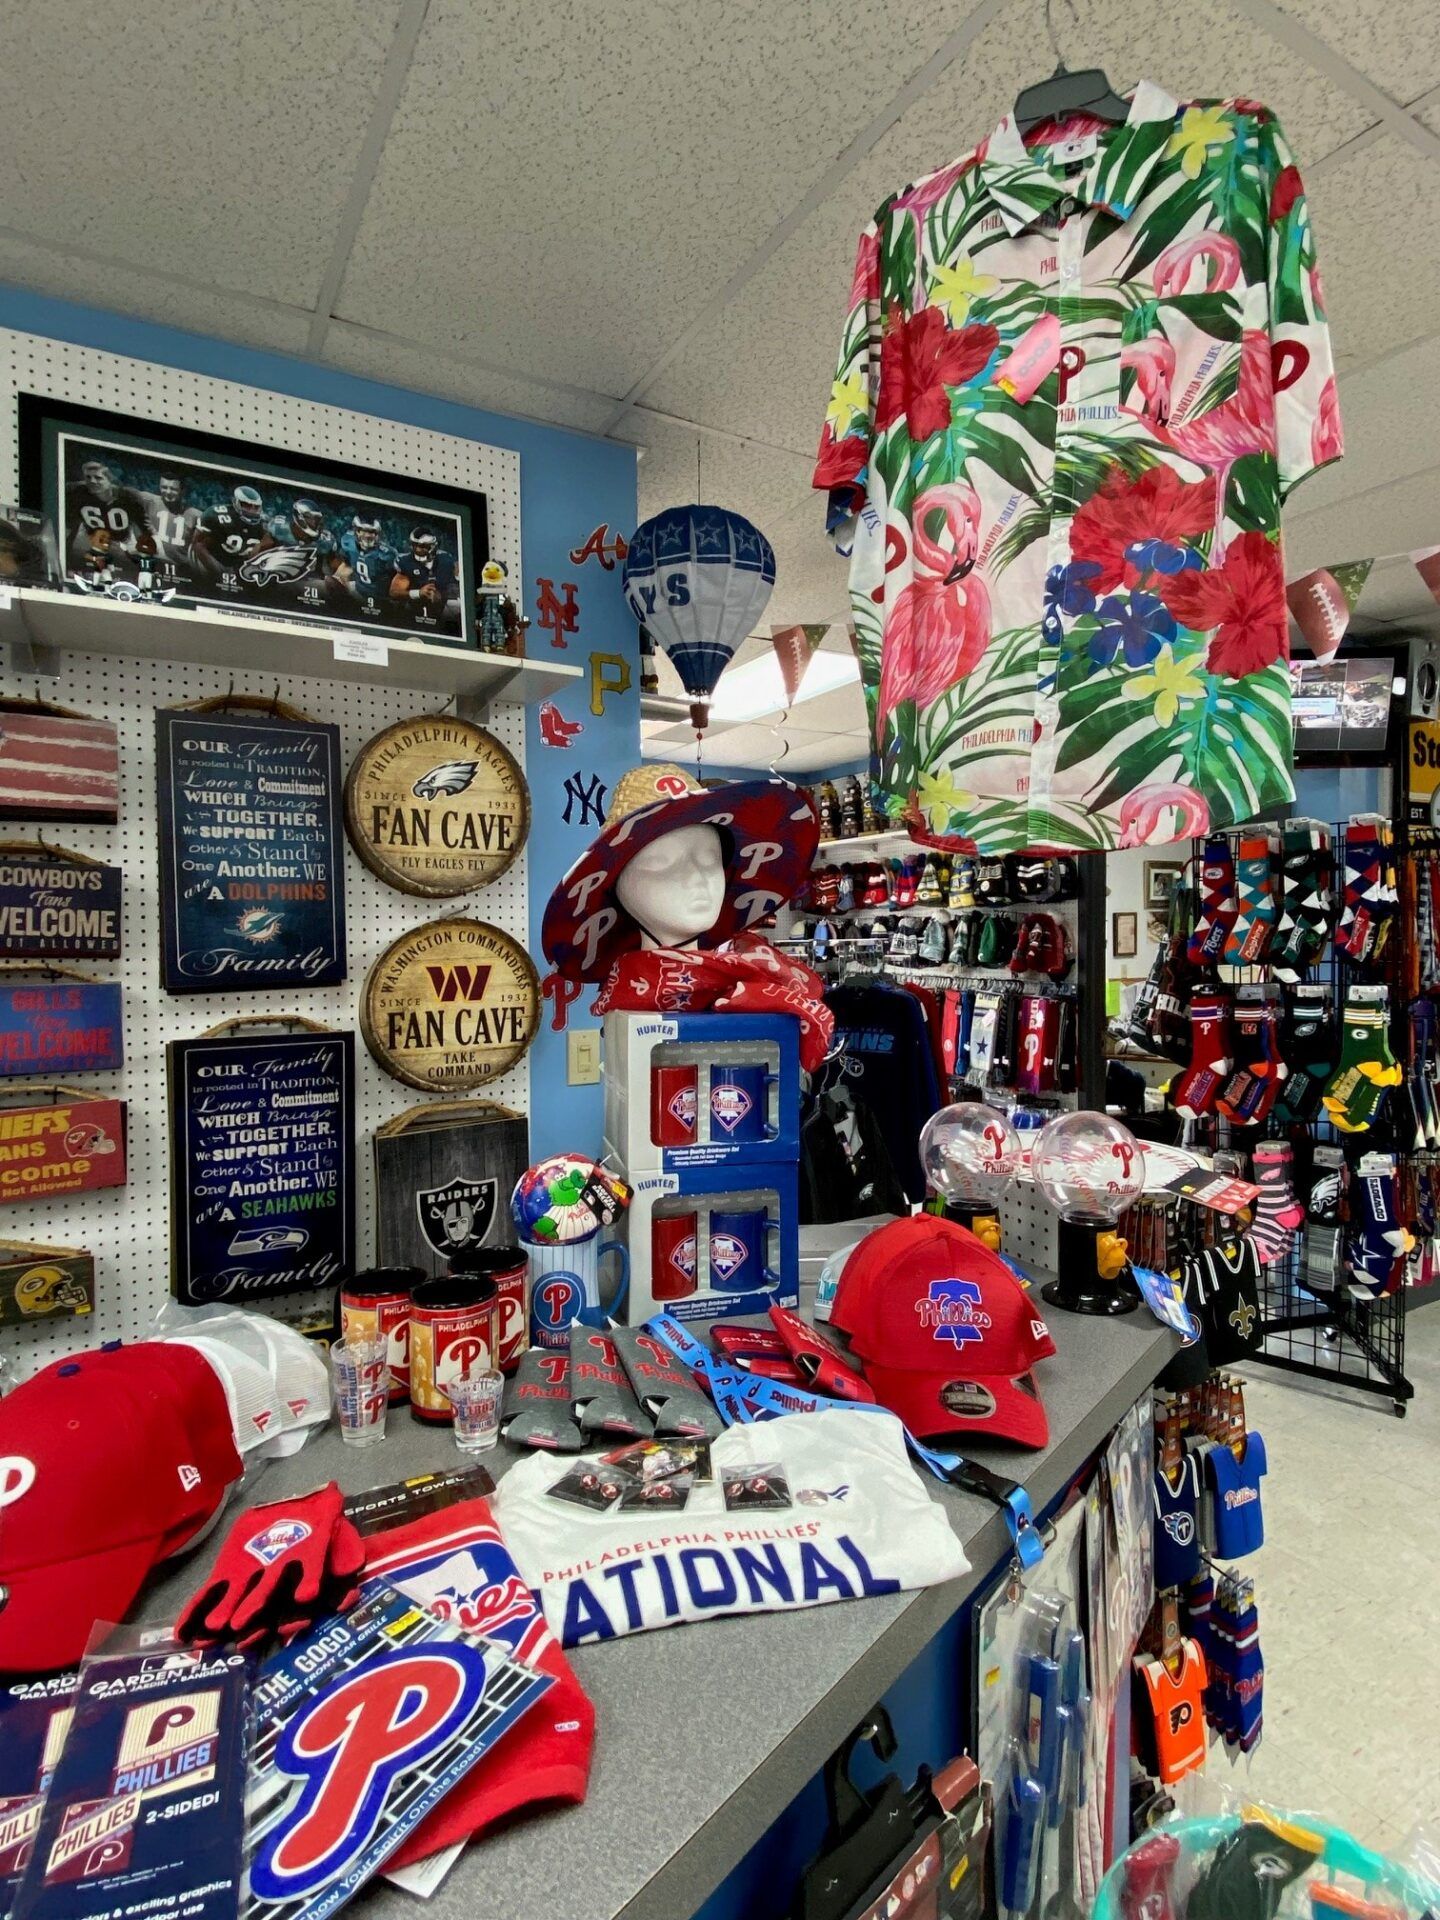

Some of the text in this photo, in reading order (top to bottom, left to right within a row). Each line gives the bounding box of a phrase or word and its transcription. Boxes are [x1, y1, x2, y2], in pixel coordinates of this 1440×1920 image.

[1078, 405, 1117, 420] PHILLIES
[81, 506, 129, 530] 60
[157, 511, 185, 546] 11
[165, 564, 176, 575] 11
[222, 573, 237, 584] 92
[357, 562, 371, 584] 9
[304, 587, 317, 598] 20
[367, 598, 374, 607] 9
[589, 652, 632, 716] P
[182, 737, 319, 763] OUR Family
[962, 729, 1015, 750] PHILADELPHIA
[368, 728, 517, 794] PHILADELPHIA EAGLES
[177, 771, 326, 796] Love & Commitment
[365, 791, 406, 801] SINCE
[184, 791, 322, 811] WHICH Brings
[488, 800, 516, 810] 1933
[213, 809, 323, 827] TOGETHER.
[372, 805, 514, 851] FAN CAVE
[182, 826, 325, 842] We SUPPORT Each
[189, 845, 228, 855] Other
[248, 843, 308, 861] Stand
[402, 856, 486, 870] FLY EAGLES FLY
[740, 841, 783, 879] P
[0, 867, 102, 890] COWBOYS
[182, 860, 214, 871] One
[303, 864, 326, 880] WE
[29, 890, 72, 907] Fans
[184, 878, 326, 900] are A DOLPHINS
[568, 870, 608, 917] P
[40, 939, 118, 949] ALLOWED
[572, 907, 618, 971] P
[1204, 925, 1224, 954] 76ers
[1245, 924, 1264, 960] Dolphins
[178, 947, 335, 978] Family
[381, 931, 530, 993] WASHINGTON COMMANDERS
[380, 998, 421, 1008] SINCE
[501, 994, 528, 1002] 1932
[540, 973, 584, 1032] P
[387, 1007, 527, 1050] FAN CAVE
[636, 1023, 675, 1037] HUNTER
[1200, 1022, 1211, 1035] P
[197, 1046, 335, 1078] OUR Family
[443, 1052, 476, 1064] TAKE
[428, 1064, 491, 1078] COMMAND
[206, 1083, 244, 1092] rooted
[192, 1089, 339, 1114] Love & Commitment
[198, 1108, 336, 1129] WHICH Brings
[226, 1122, 335, 1145] TOGETHER.
[984, 1125, 1006, 1160] P
[196, 1138, 338, 1162] We SUPPORT Each
[1112, 1142, 1134, 1178] P
[201, 1167, 240, 1178] Other
[260, 1153, 319, 1176] Stand
[30, 1178, 81, 1193] Allowed
[194, 1185, 226, 1196] One
[314, 1170, 337, 1188] WE
[426, 1185, 488, 1204] RAIDERS
[637, 1179, 676, 1192] HUNTER
[195, 1190, 336, 1224] are A SEAHAWKS
[188, 1253, 345, 1300] Family
[543, 1282, 572, 1324] P
[915, 1298, 992, 1328] Phillies
[438, 1316, 488, 1332] PHILADELPHIA
[449, 1336, 481, 1382] P
[365, 1394, 385, 1424] P
[344, 1477, 465, 1517] SPORTS TOWEL
[1224, 1487, 1258, 1511] Phillies
[543, 1532, 716, 1584] PHILADELPHIA
[531, 1535, 899, 1650] ATIONAL
[89, 1655, 245, 1695] GARDEN FLAG
[253, 1626, 351, 1705] THE GOGO
[257, 1615, 388, 1722] TO YOUR FRONT CAR GRILLE
[20, 1688, 47, 1700] PARA
[99, 1667, 229, 1700] PARA JARDIN BANDERA
[145, 1705, 195, 1748] P
[114, 1743, 210, 1795] PHILLIES
[265, 1651, 472, 1884] P
[51, 1797, 136, 1866] PHILLIES
[340, 1858, 373, 1892] Your
[372, 1820, 408, 1858] Spirit
[408, 1800, 429, 1820] On
[428, 1778, 451, 1799] the
[84, 1840, 124, 1876] P
[113, 1880, 232, 1918] & exciting graphics
[183, 1903, 205, 1916] use
